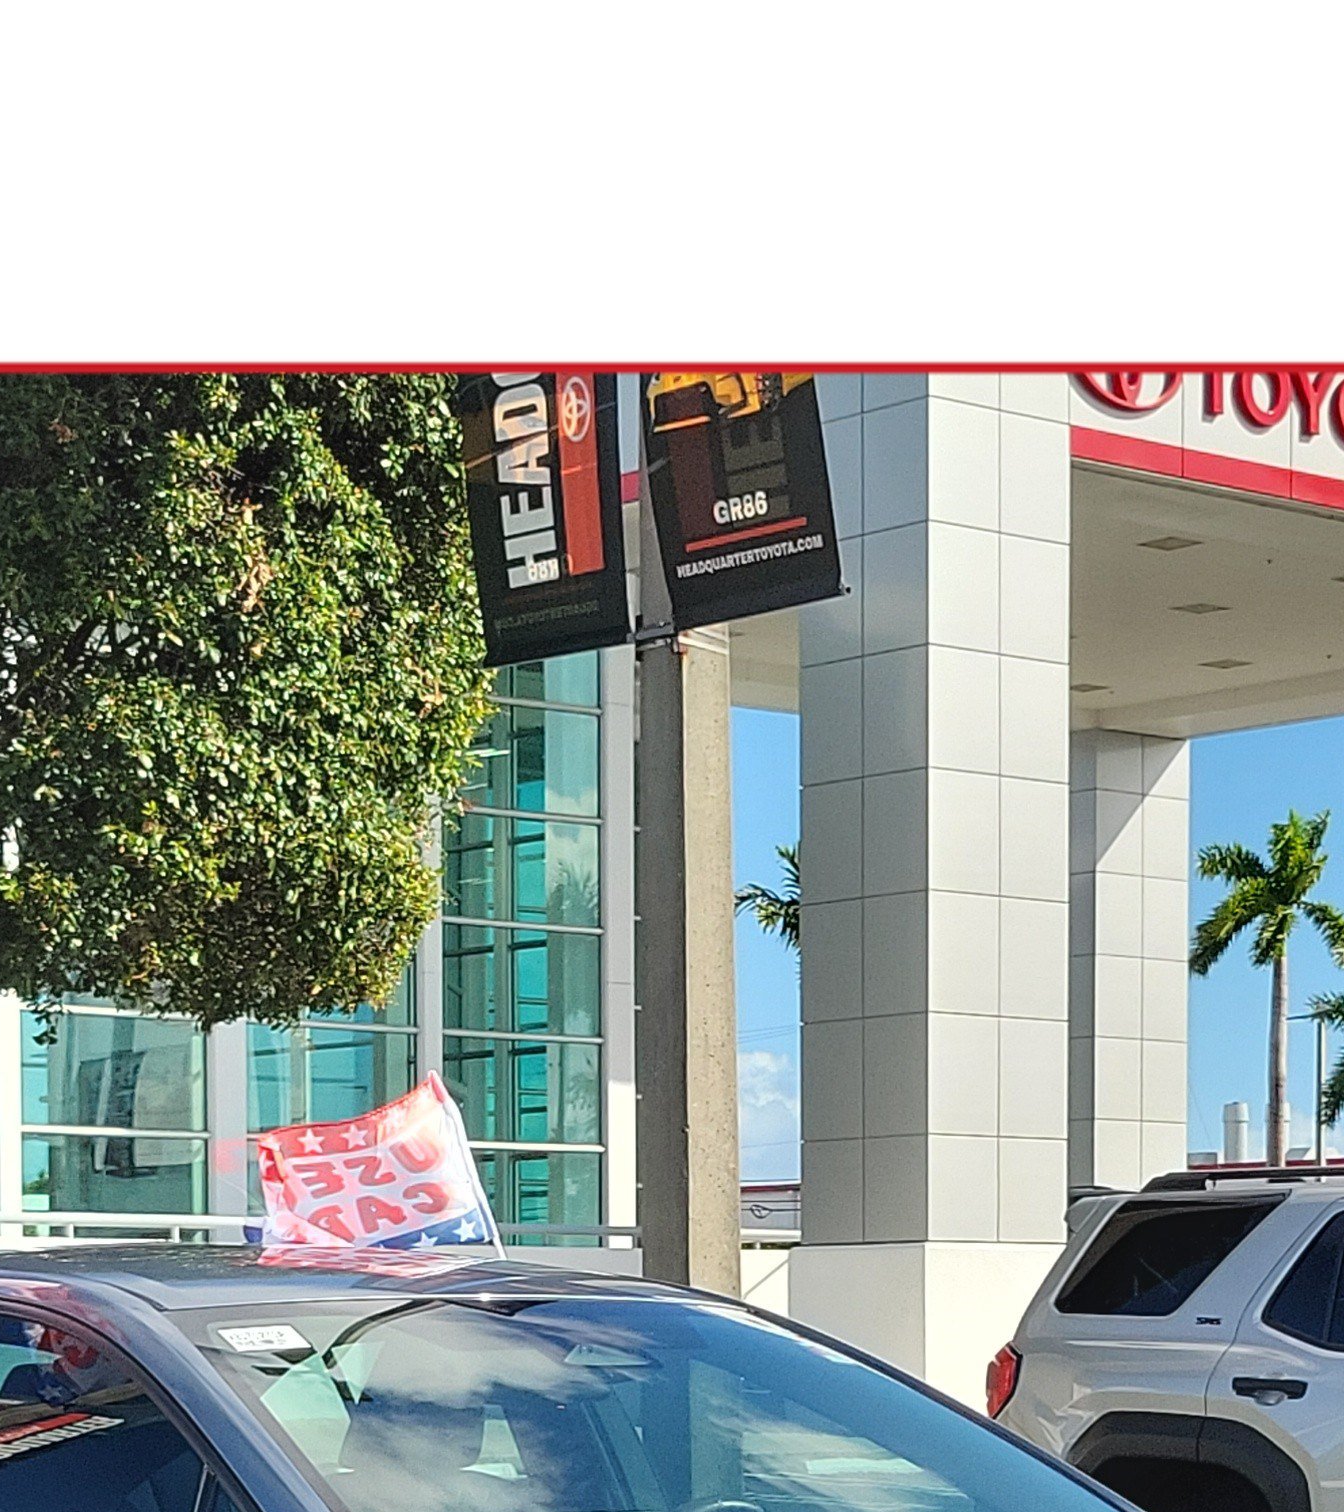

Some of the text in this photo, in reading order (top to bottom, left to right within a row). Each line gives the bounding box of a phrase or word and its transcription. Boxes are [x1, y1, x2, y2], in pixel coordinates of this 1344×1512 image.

[492, 373, 561, 590] HEAD
[712, 490, 769, 525] GR86
[675, 533, 825, 579] HEADQUARTERTOYOTA.COM
